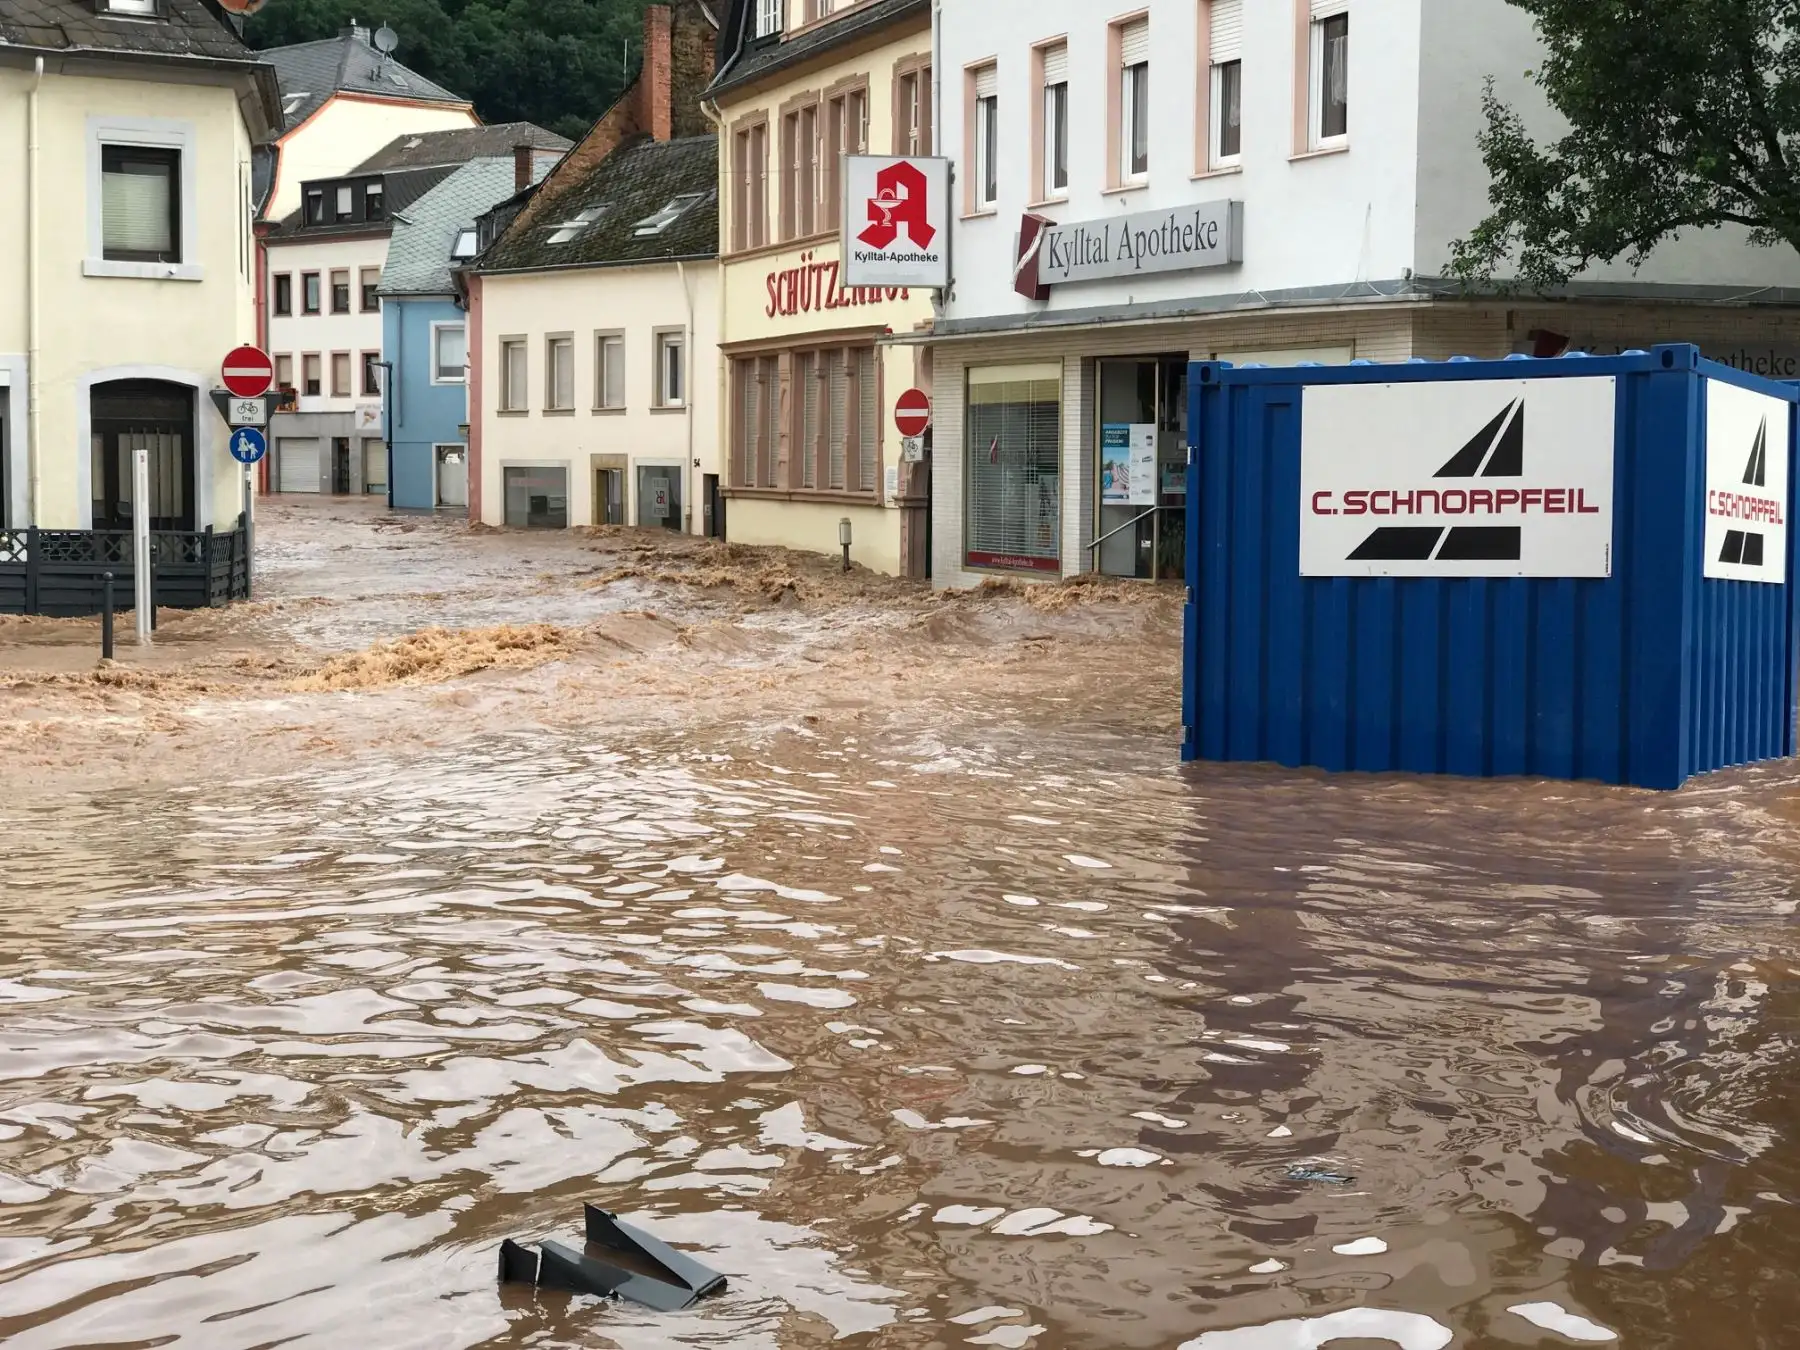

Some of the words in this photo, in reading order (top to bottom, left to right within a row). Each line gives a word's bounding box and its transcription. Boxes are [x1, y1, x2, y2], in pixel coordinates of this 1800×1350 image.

[854, 251, 939, 264] Kylltal-Apotheke
[1048, 223, 1110, 277] Kylltal
[1117, 209, 1218, 269] Apotheke
[765, 250, 910, 318] SCHÜTZ
[1703, 348, 1797, 376] theke
[1311, 488, 1600, 515] C.SCHNORPFEIL
[1709, 489, 1784, 525] C.SCHNORPFEIL
